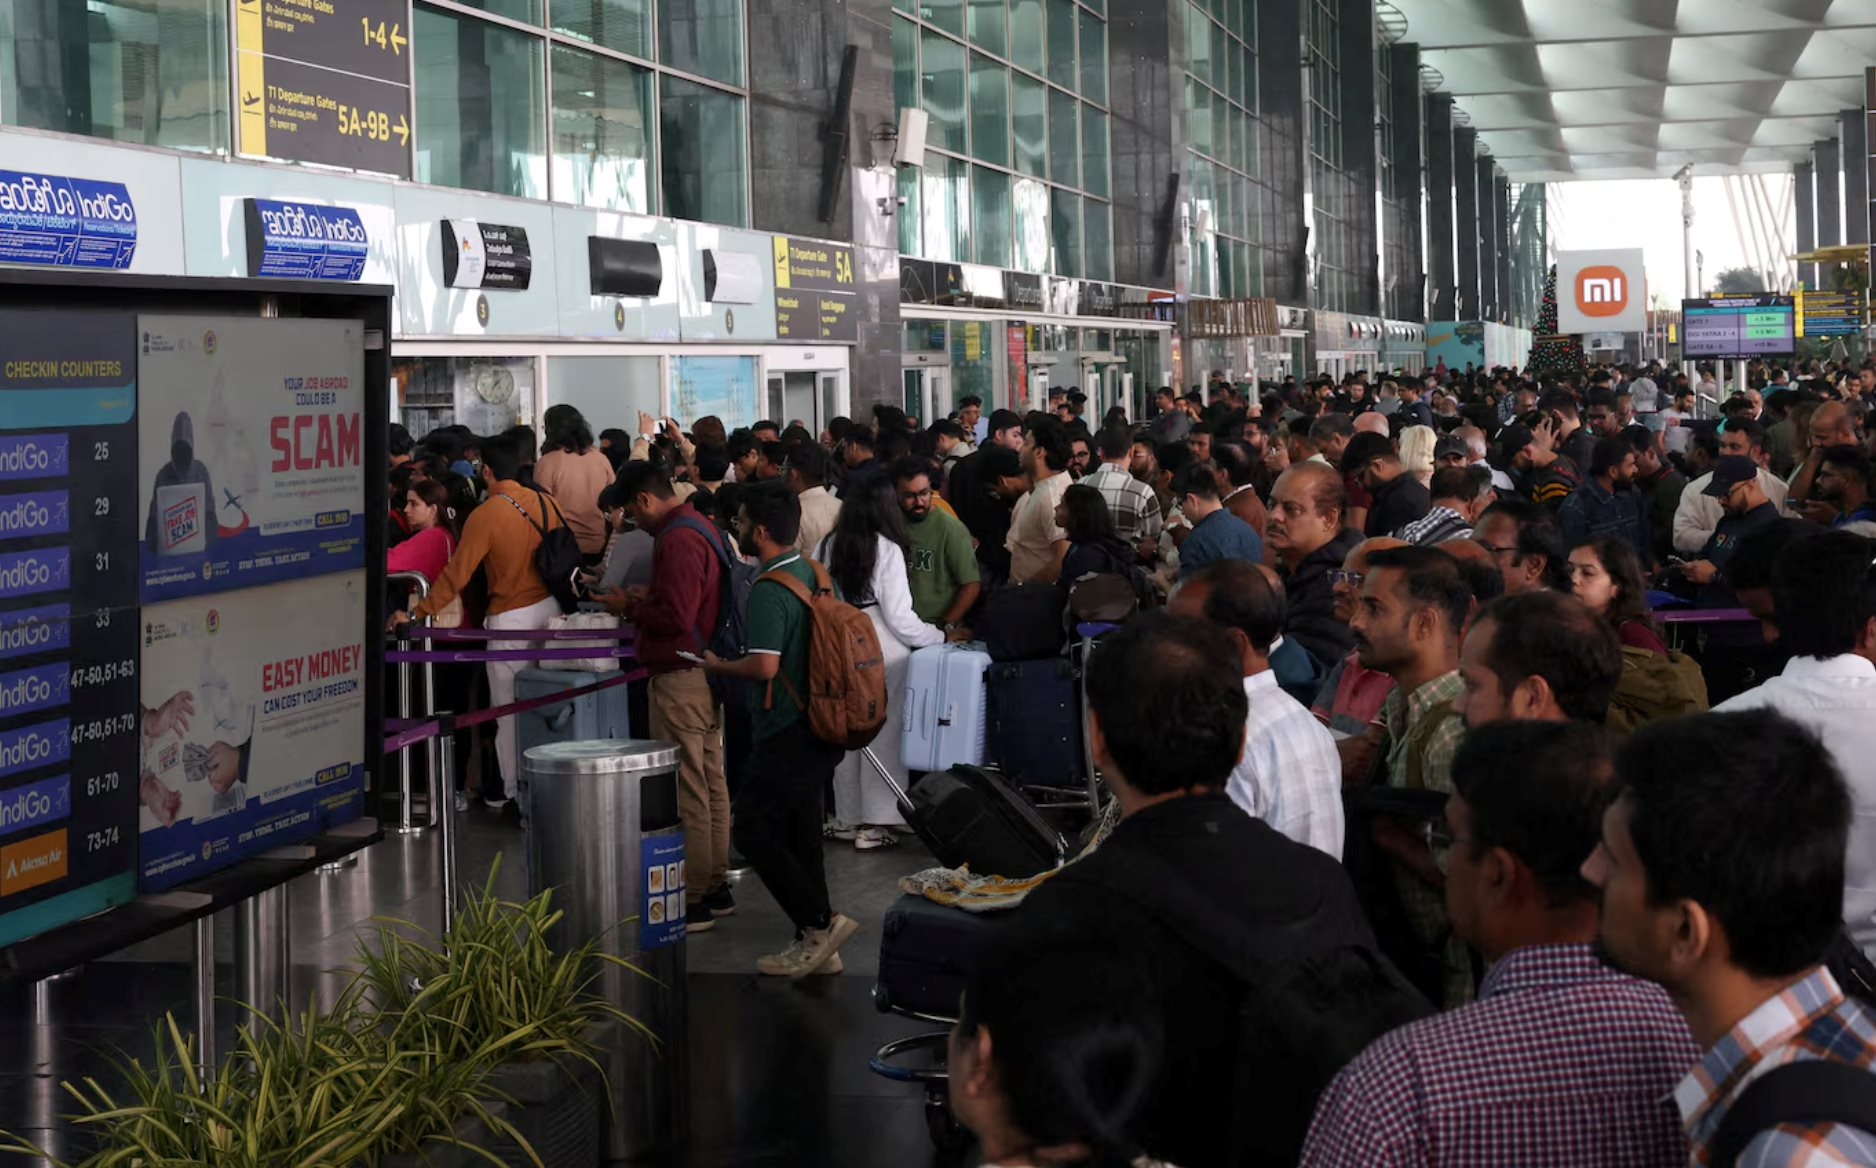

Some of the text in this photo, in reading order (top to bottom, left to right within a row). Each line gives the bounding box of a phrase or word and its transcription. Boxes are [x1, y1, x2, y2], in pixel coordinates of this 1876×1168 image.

[314, 0, 335, 15] Gates
[361, 17, 387, 50] 1-4
[268, 85, 337, 110] T1 Departure Gates
[338, 105, 390, 141] 5A-9B
[77, 190, 134, 222] IndiGo
[322, 216, 365, 242] IndiGo
[835, 250, 853, 283] 5A
[5, 360, 122, 378] CHECKIN COUNTERS
[284, 376, 349, 390] YOUR JOB ABROAD
[296, 391, 337, 405] COULD BE A
[94, 441, 109, 461] 25
[270, 411, 360, 473] SCAM
[95, 496, 110, 516] 29
[183, 507, 195, 522] JOB
[171, 519, 194, 542] SCAM
[96, 551, 109, 571] 31
[96, 607, 110, 628] 33
[71, 659, 134, 688] 47-50,51-63
[263, 643, 360, 692] EASY MONEY
[264, 678, 358, 714] CAN COST YOUR FREEDOM
[71, 713, 134, 744] 47-50,51-70
[87, 771, 119, 796] 51-70
[87, 826, 119, 852] 73-74
[20, 848, 62, 874] Akasa Air
